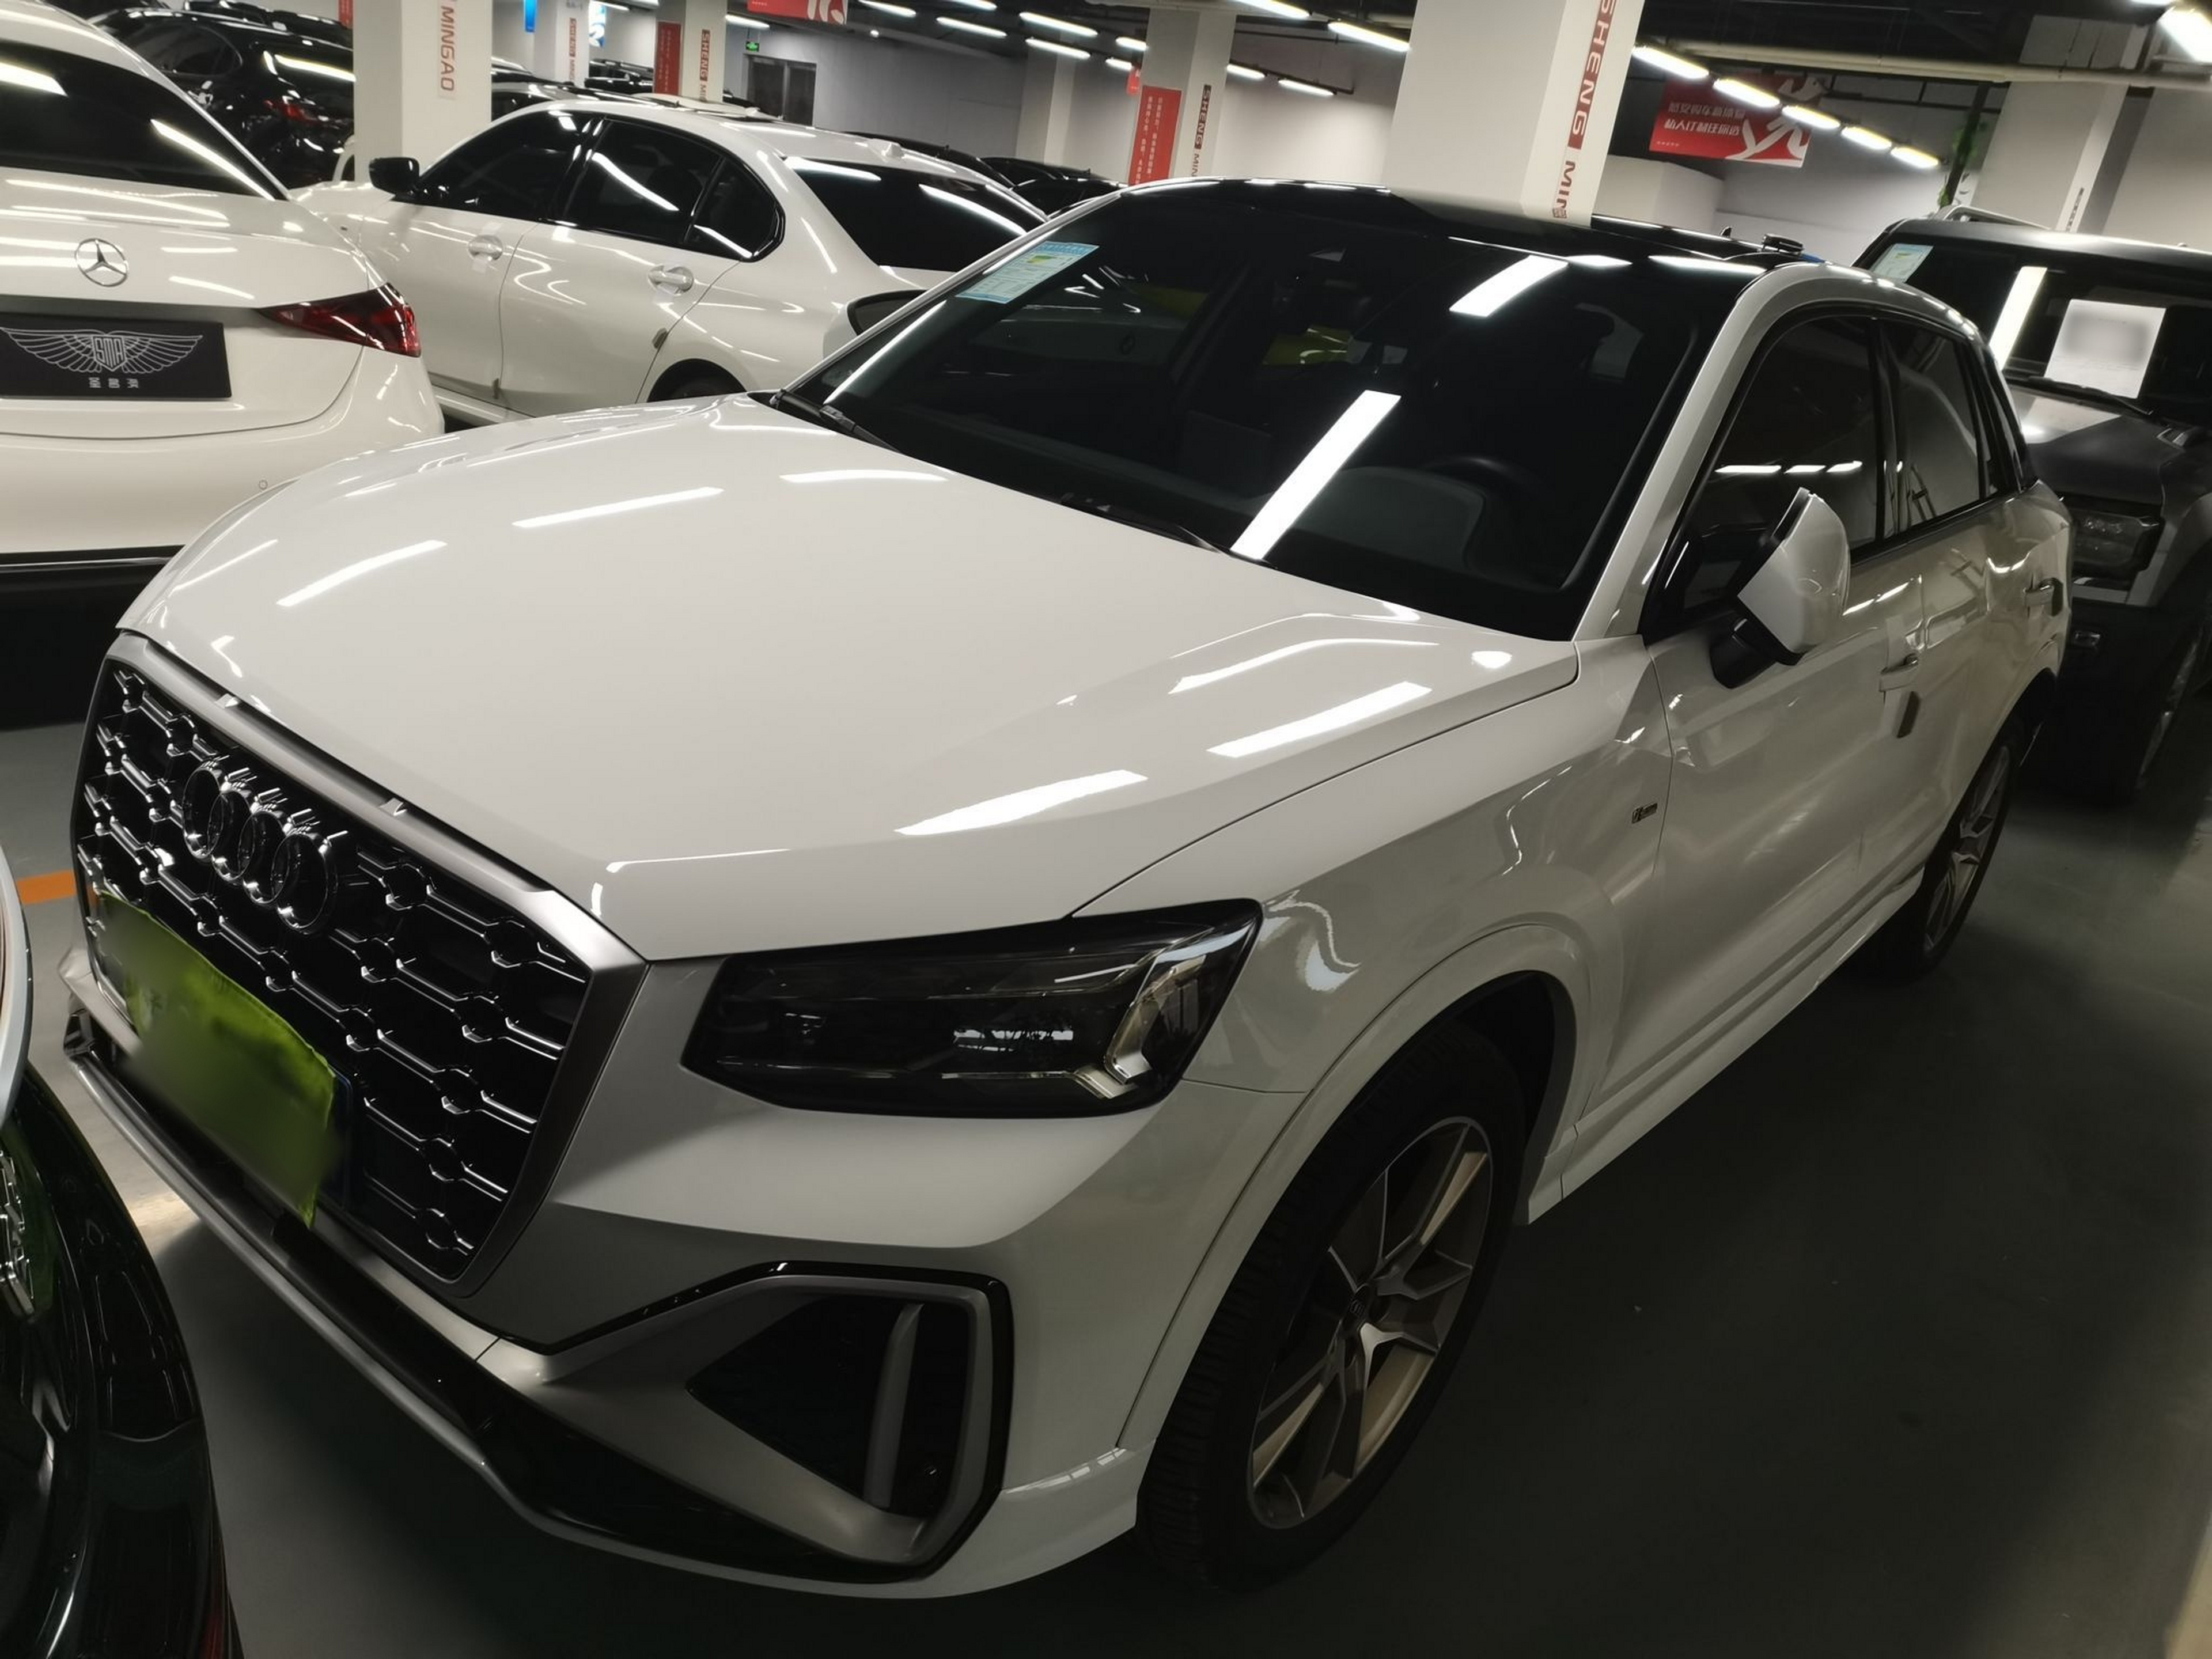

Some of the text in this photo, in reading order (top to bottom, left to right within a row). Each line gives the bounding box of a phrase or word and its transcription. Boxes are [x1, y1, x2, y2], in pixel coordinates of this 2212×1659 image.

[441, 5, 454, 91] MINGAO
[700, 31, 710, 77] SHENG
[1572, 0, 1615, 136] SHENG
[1195, 88, 1211, 145] SHENG
